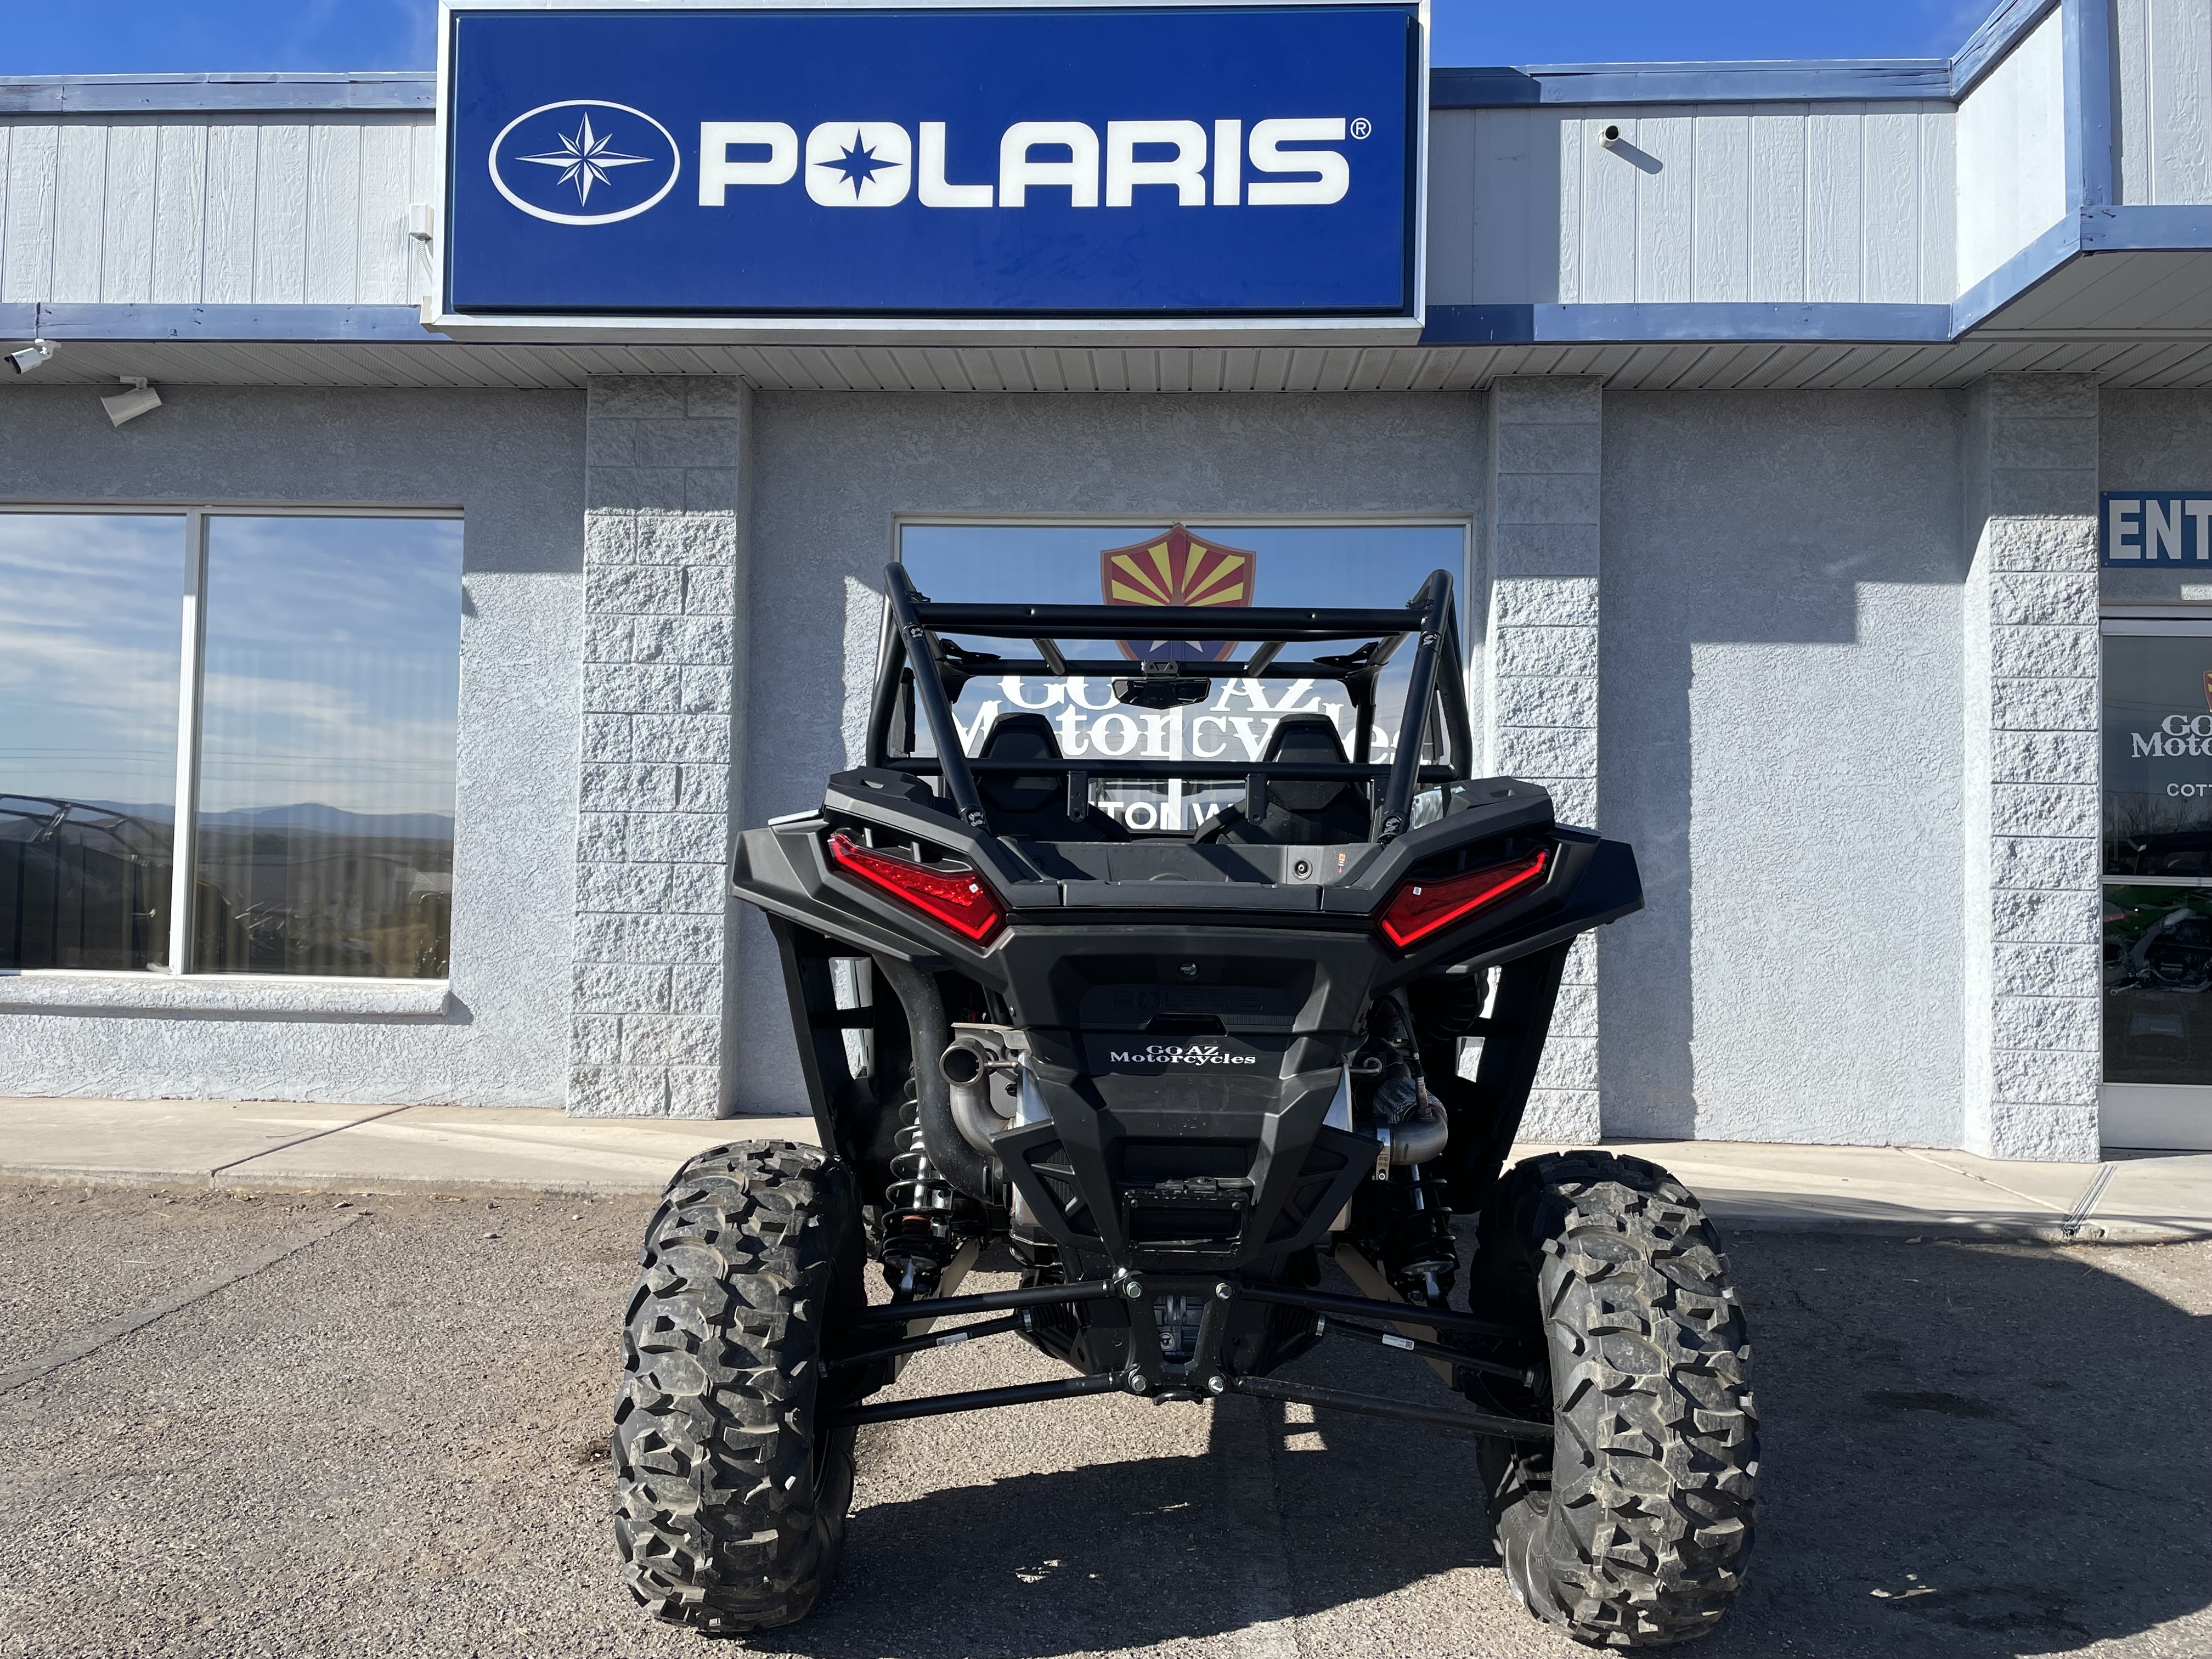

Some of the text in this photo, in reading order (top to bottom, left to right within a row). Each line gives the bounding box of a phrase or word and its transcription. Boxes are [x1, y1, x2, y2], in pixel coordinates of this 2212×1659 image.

[2160, 715, 2212, 736] GO
[1146, 1045, 1220, 1056] GO AZ
[1110, 1051, 1256, 1066] Motorcycles
